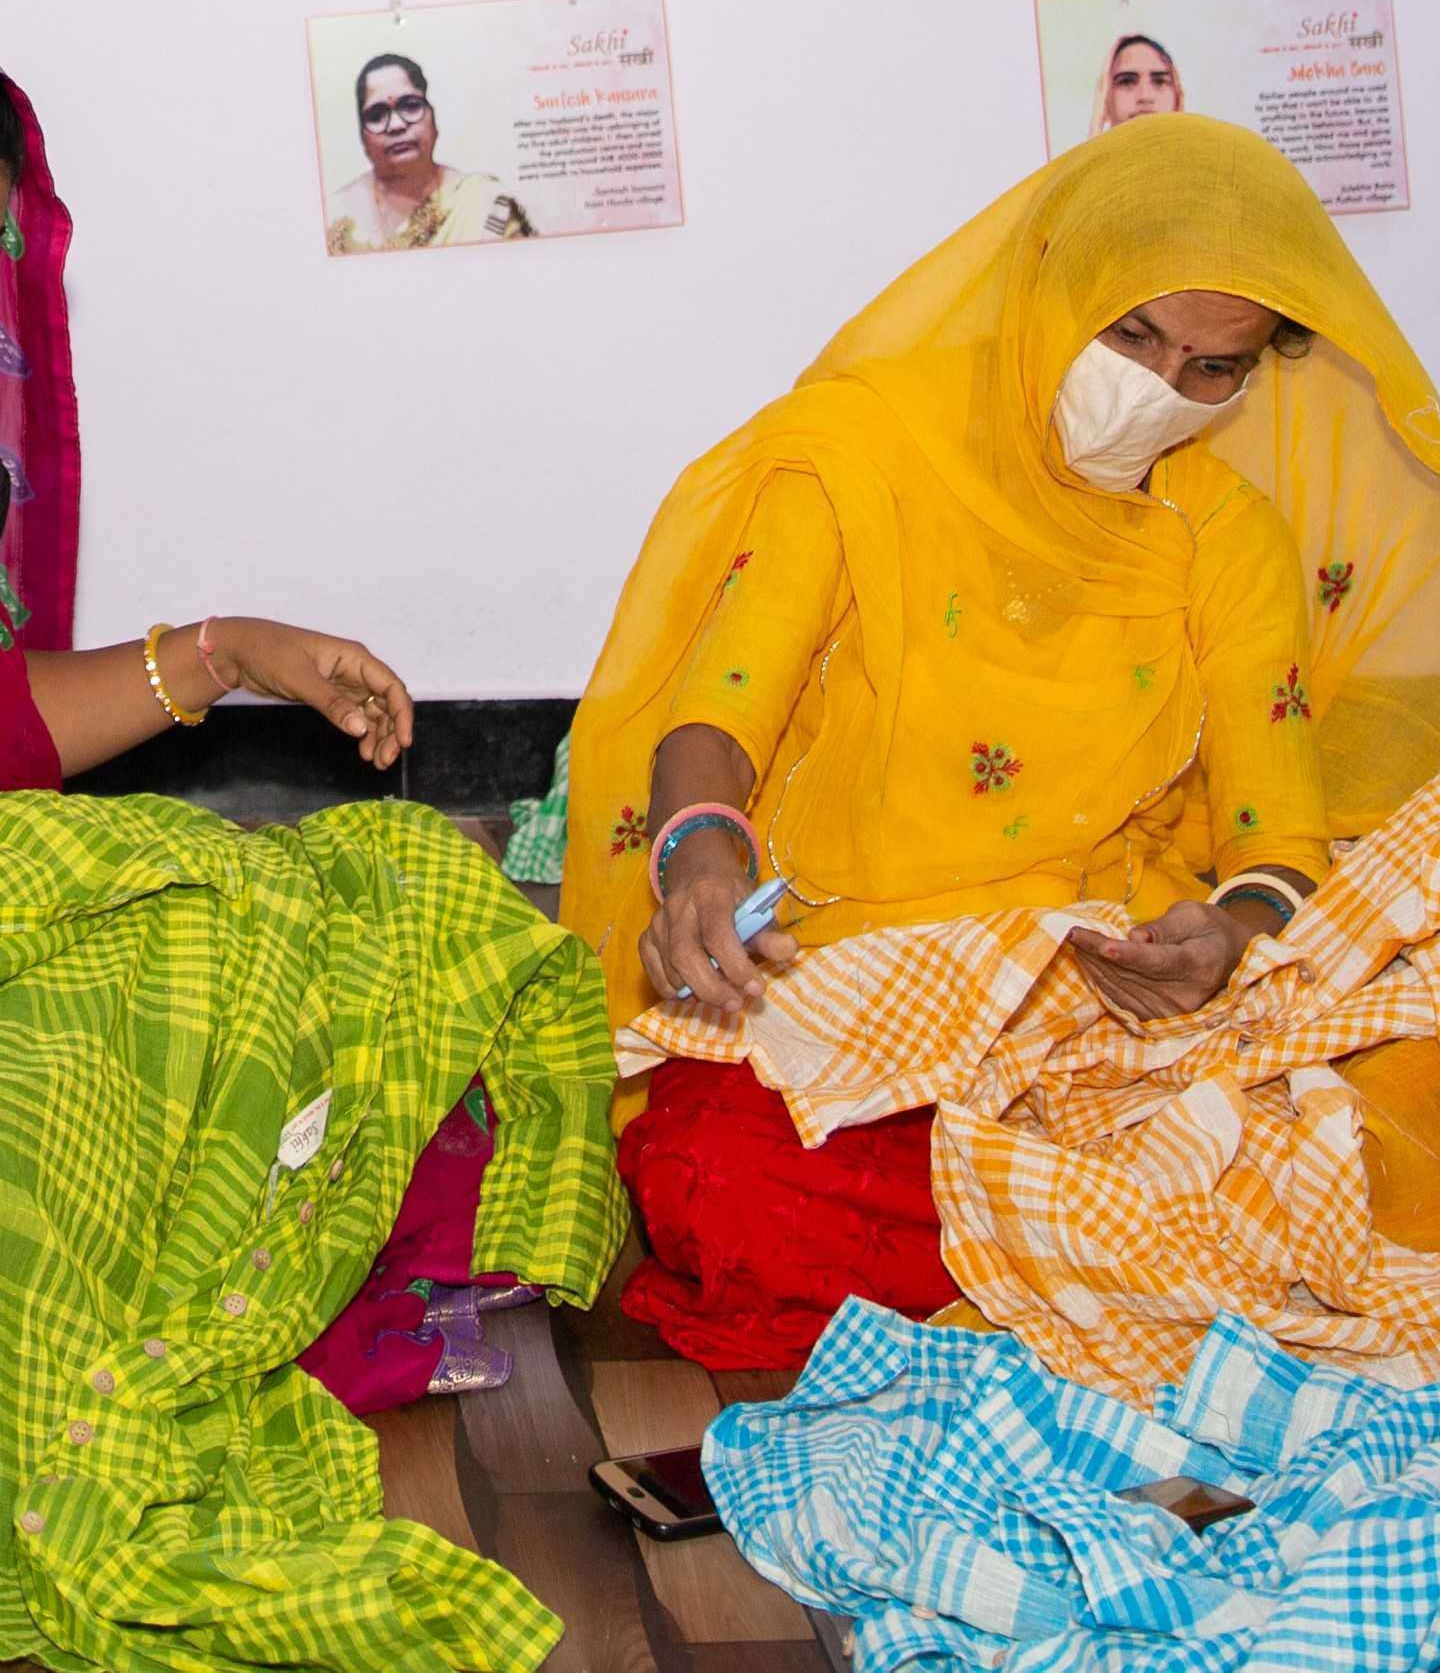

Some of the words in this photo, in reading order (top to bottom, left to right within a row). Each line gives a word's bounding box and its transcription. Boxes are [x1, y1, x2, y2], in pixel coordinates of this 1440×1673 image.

[1298, 12, 1359, 40] Sakhi
[566, 28, 630, 57] Sakhi
[290, 1120, 319, 1152] Sakhi
